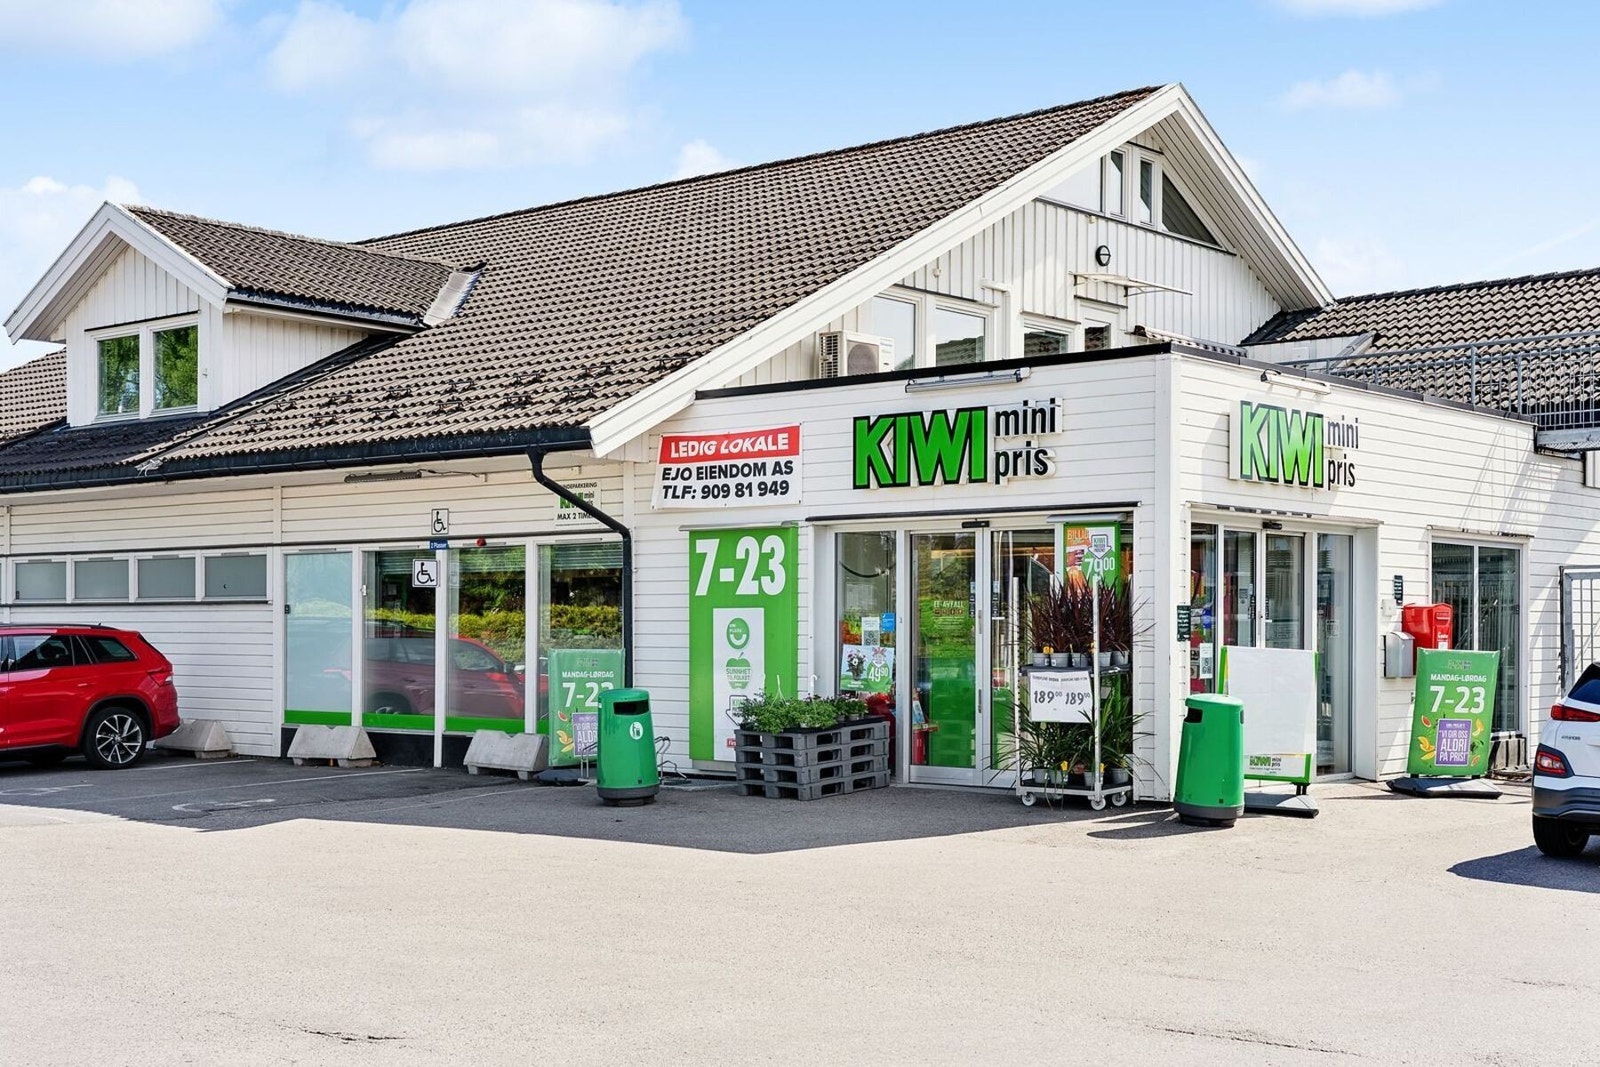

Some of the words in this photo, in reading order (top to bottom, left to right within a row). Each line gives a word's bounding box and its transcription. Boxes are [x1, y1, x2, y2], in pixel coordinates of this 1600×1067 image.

[995, 398, 1056, 436] mini
[1328, 414, 1358, 449] mini
[670, 440, 718, 458] LEDIG
[720, 433, 789, 454] LOKALE
[853, 406, 988, 489] KIWI
[1240, 400, 1324, 488] KIWI
[661, 467, 693, 481] EJO
[696, 462, 767, 480] EIENDOM
[771, 460, 794, 476] AS
[995, 440, 1049, 485] pris
[1328, 453, 1356, 491] pris
[662, 485, 696, 499] TLF:
[700, 483, 731, 499] 909
[734, 482, 753, 498] 81
[757, 480, 790, 497] 949
[557, 512, 571, 521] MAX
[572, 512, 577, 520] 2
[694, 534, 787, 597] 7-23
[561, 671, 615, 679] MANDAG-LØRDAG
[1430, 673, 1488, 683] MANDAG-LØRDAG
[1429, 685, 1486, 714] 7-23
[1440, 738, 1468, 752] ALDRI
